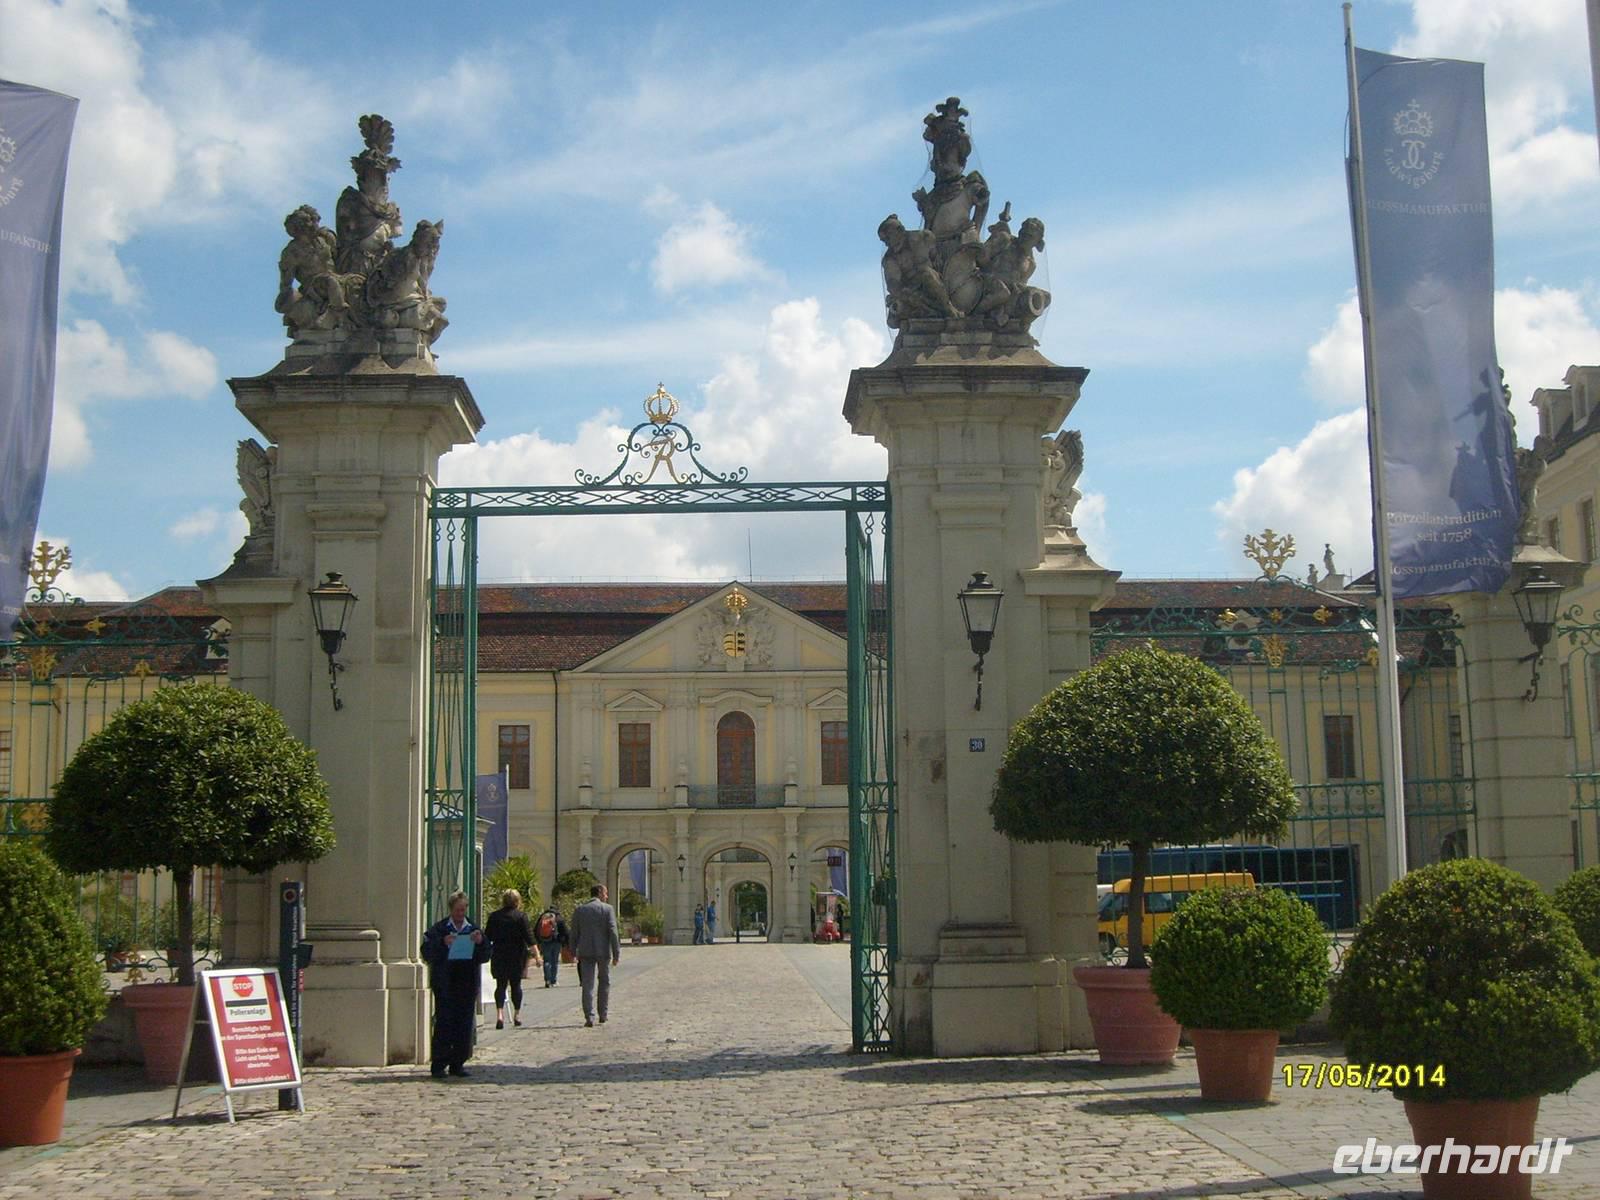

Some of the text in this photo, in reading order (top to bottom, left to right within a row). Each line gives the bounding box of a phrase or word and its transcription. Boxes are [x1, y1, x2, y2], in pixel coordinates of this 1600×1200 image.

[1387, 509, 1502, 525] Porzellantradition
[1417, 528, 1472, 543] seit 1758
[232, 982, 252, 991] STOP
